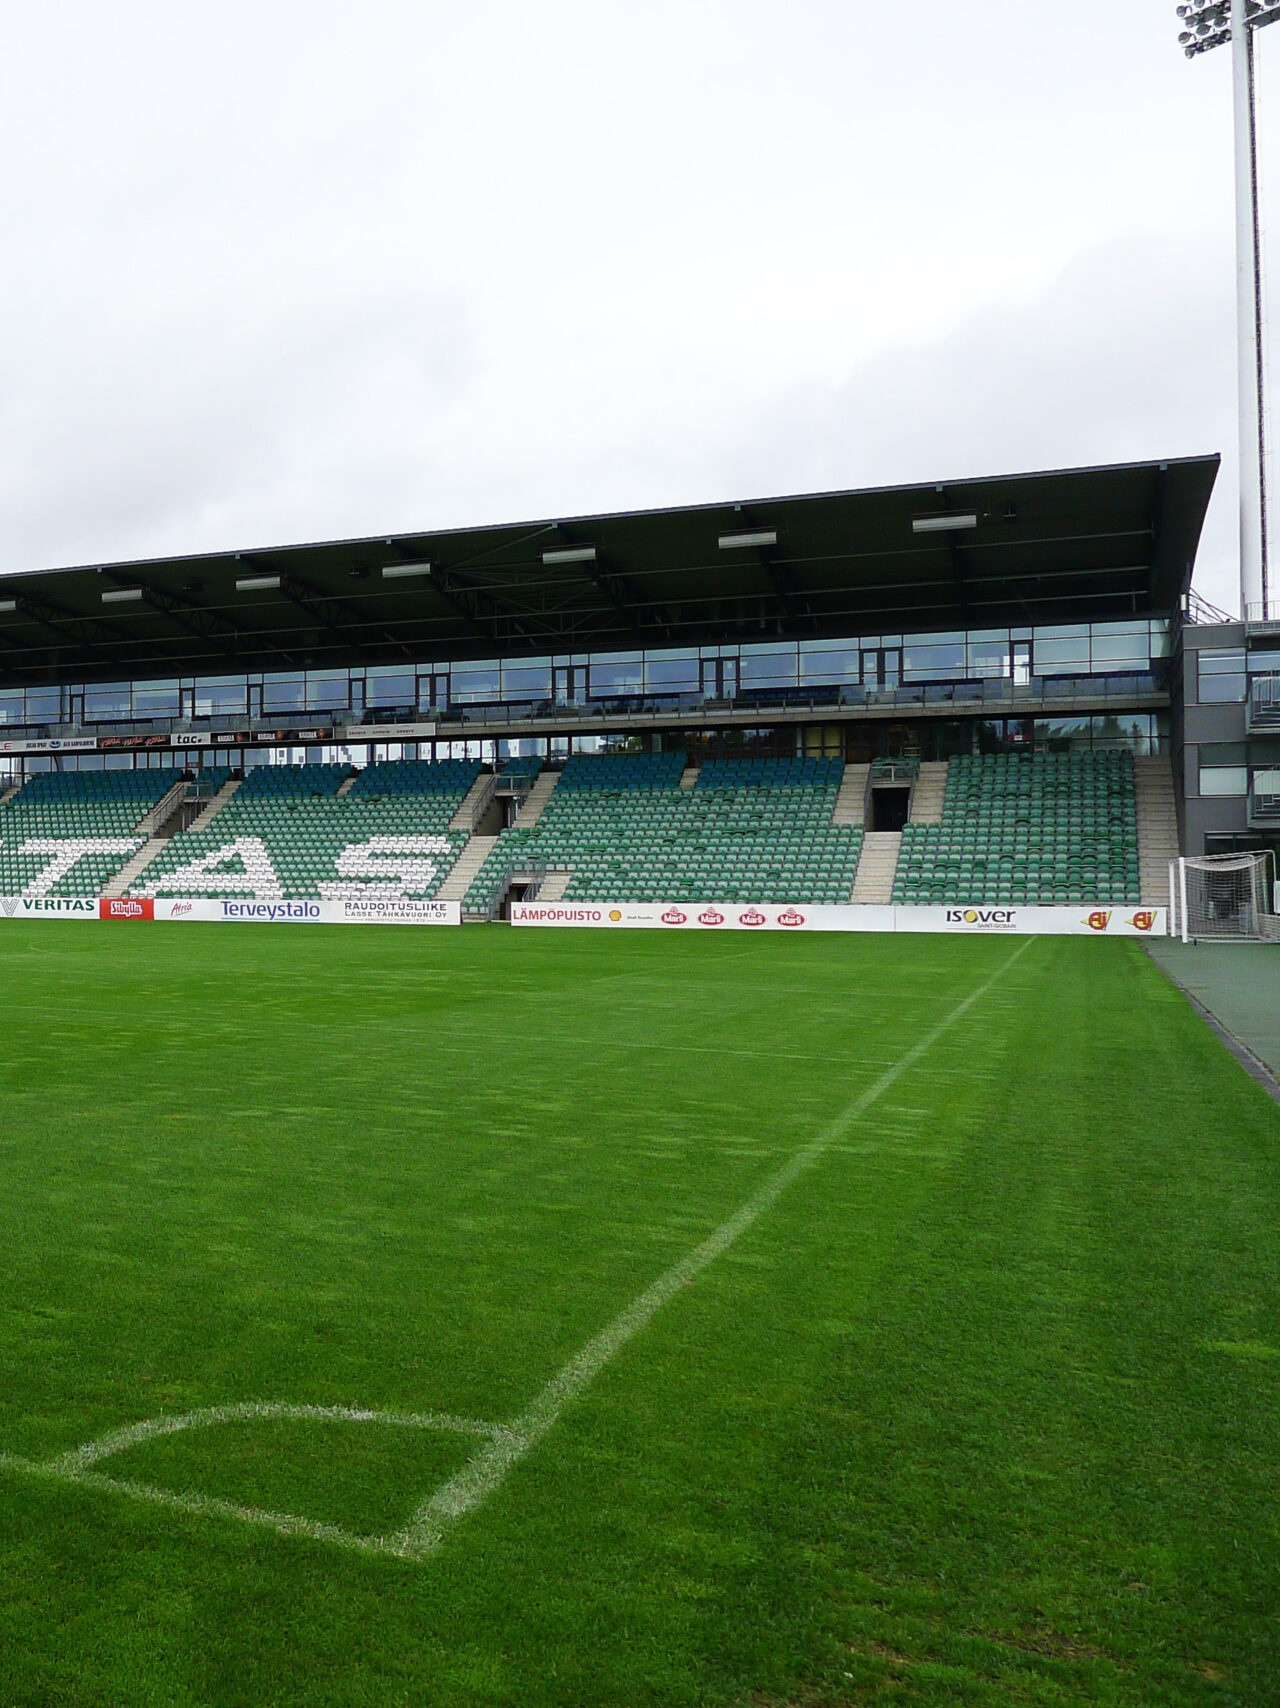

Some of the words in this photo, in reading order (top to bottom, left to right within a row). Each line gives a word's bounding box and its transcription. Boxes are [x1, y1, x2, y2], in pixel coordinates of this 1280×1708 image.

[22, 899, 95, 911] VERITAS
[110, 901, 142, 917] Sibylla
[170, 902, 193, 915] Atria
[220, 900, 320, 920] Terveystalo
[344, 902, 447, 911] RAUDOITUSLIIKE
[513, 908, 601, 921] LÄMPÖPUISTO
[663, 914, 684, 922] Marli
[700, 914, 721, 923] Marli
[741, 915, 763, 923] Marli
[779, 915, 801, 924] Marli
